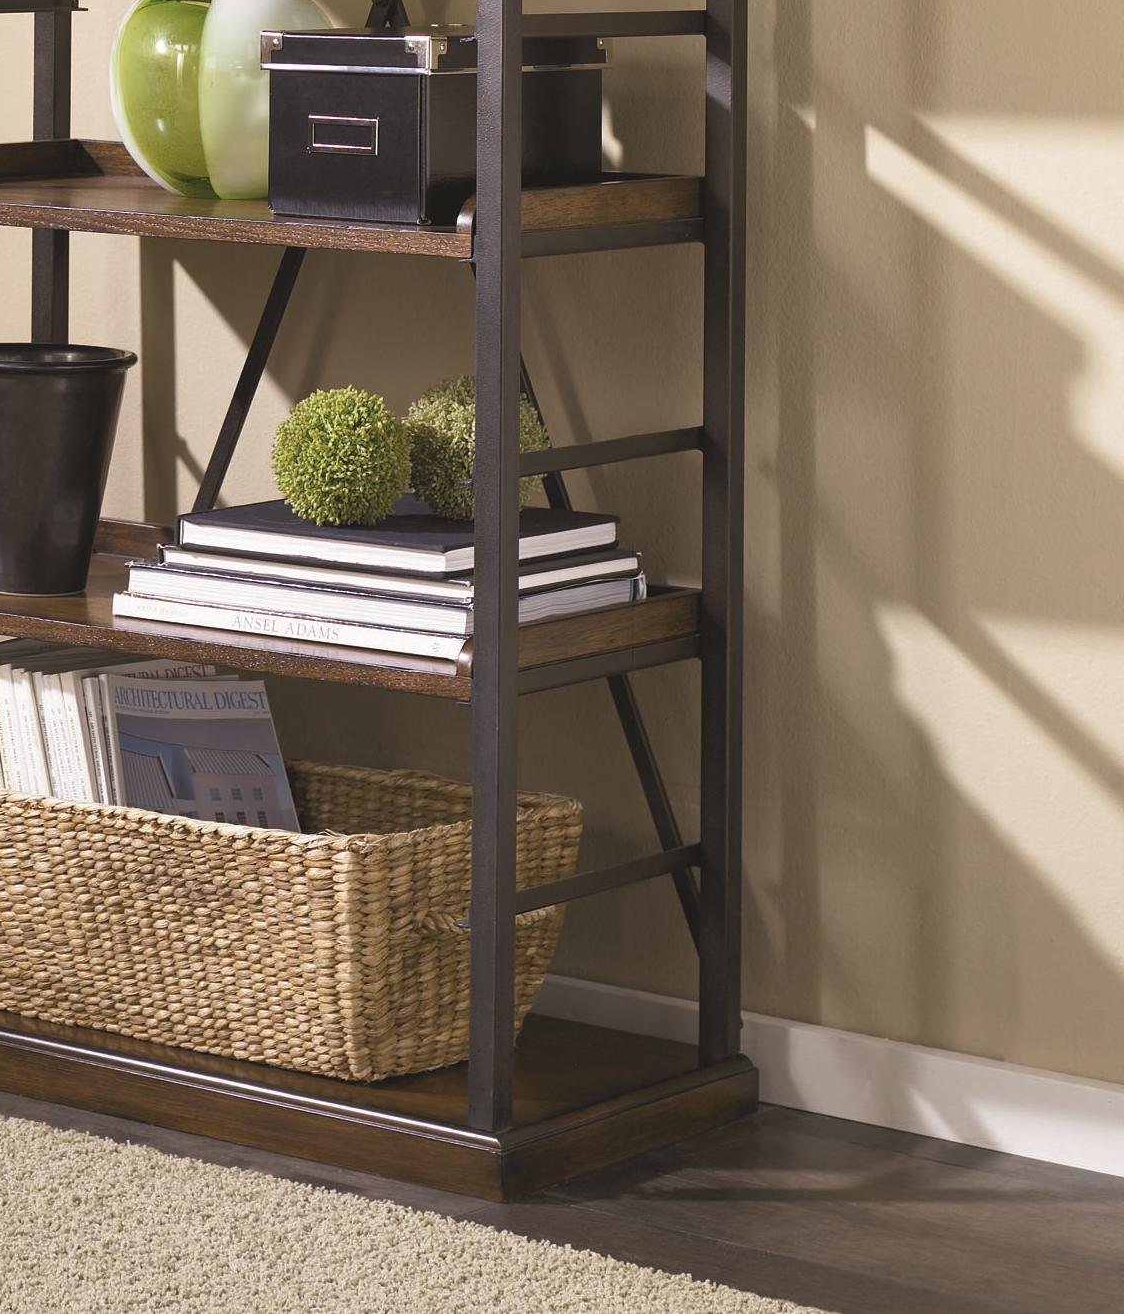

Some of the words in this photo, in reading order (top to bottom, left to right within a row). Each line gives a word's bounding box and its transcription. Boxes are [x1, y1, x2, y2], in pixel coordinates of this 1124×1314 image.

[232, 613, 279, 634] ANSEL
[285, 622, 340, 640] ADAMS
[114, 686, 213, 710] ARCHITECTURAL
[213, 691, 266, 710] DIGEST
